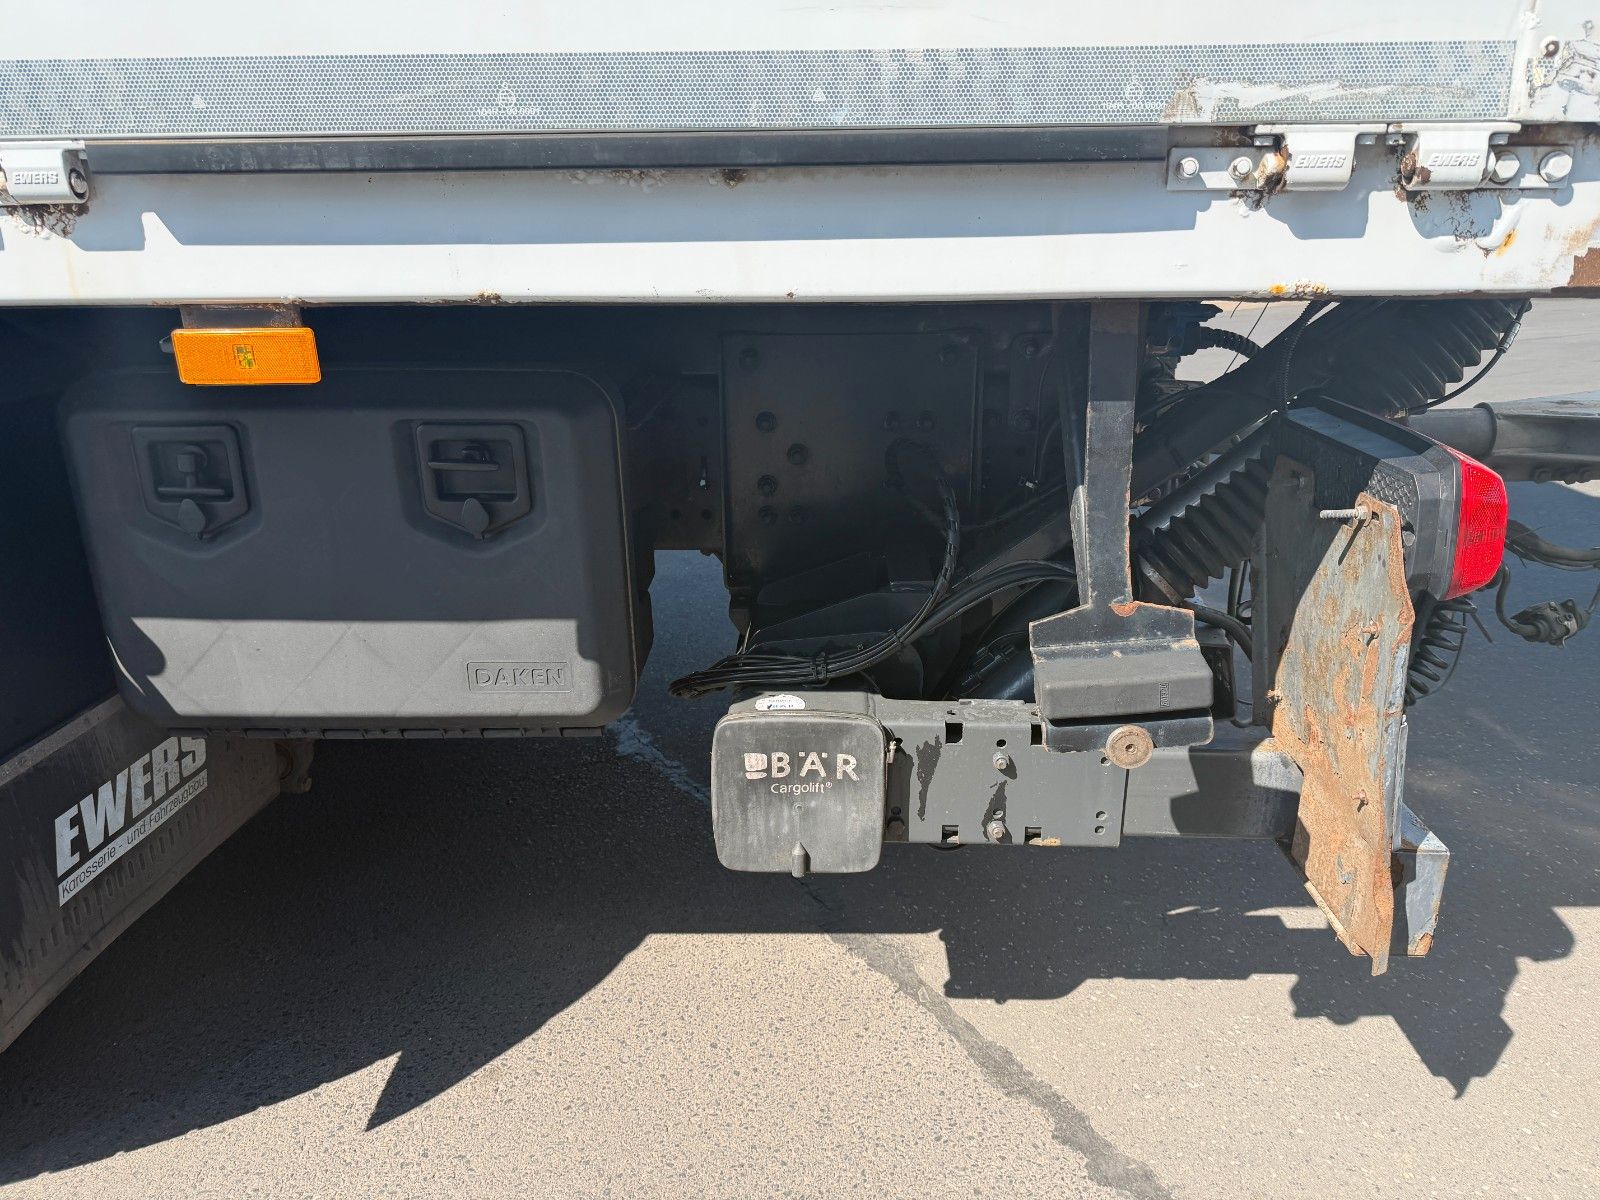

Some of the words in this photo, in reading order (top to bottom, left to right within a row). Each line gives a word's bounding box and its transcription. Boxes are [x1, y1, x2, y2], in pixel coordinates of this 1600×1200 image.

[1294, 154, 1347, 169] EWERS
[1428, 152, 1480, 167] EWERS
[13, 171, 59, 185] EWERS
[475, 668, 565, 687] DAKEN
[771, 751, 860, 781] BÄR
[55, 737, 206, 878] EWERS
[62, 846, 116, 898] Karosserie
[126, 819, 146, 845] und
[149, 776, 205, 828] Fahrzeugbau
